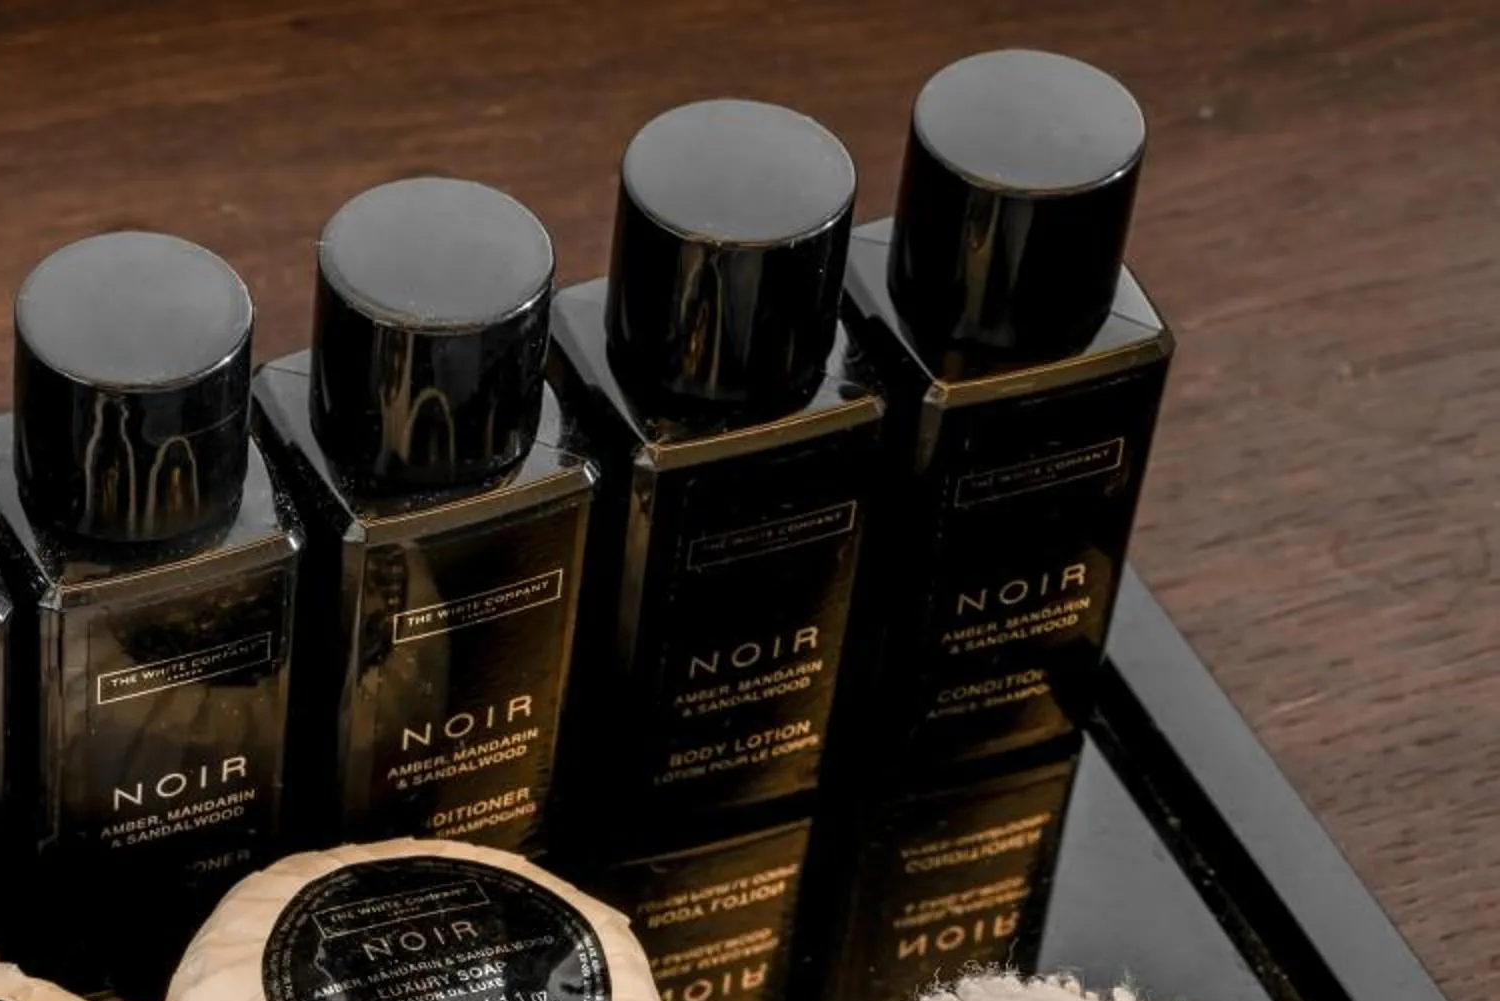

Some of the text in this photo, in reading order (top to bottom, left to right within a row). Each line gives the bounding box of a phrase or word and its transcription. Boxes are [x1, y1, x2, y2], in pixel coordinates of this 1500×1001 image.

[407, 613, 432, 627] THE
[485, 580, 550, 607] COMPANY
[956, 562, 1087, 617] NOIR
[689, 625, 820, 680] NOIR
[111, 674, 137, 688] THE
[143, 661, 187, 681] WHITE
[403, 694, 533, 751] NOIR
[669, 719, 812, 768] BODY LOTION
[453, 727, 540, 761] MANDARIN
[112, 754, 248, 813] NOIR
[412, 744, 528, 787] SANDALWOOD
[167, 787, 258, 821] MANDARIN
[425, 787, 530, 829] DITIONER
[127, 806, 245, 847] SANDALWOOD
[362, 920, 479, 962] NOIR
[376, 960, 508, 1000] LUXURY SOAP
[469, 976, 505, 994] LUXE
